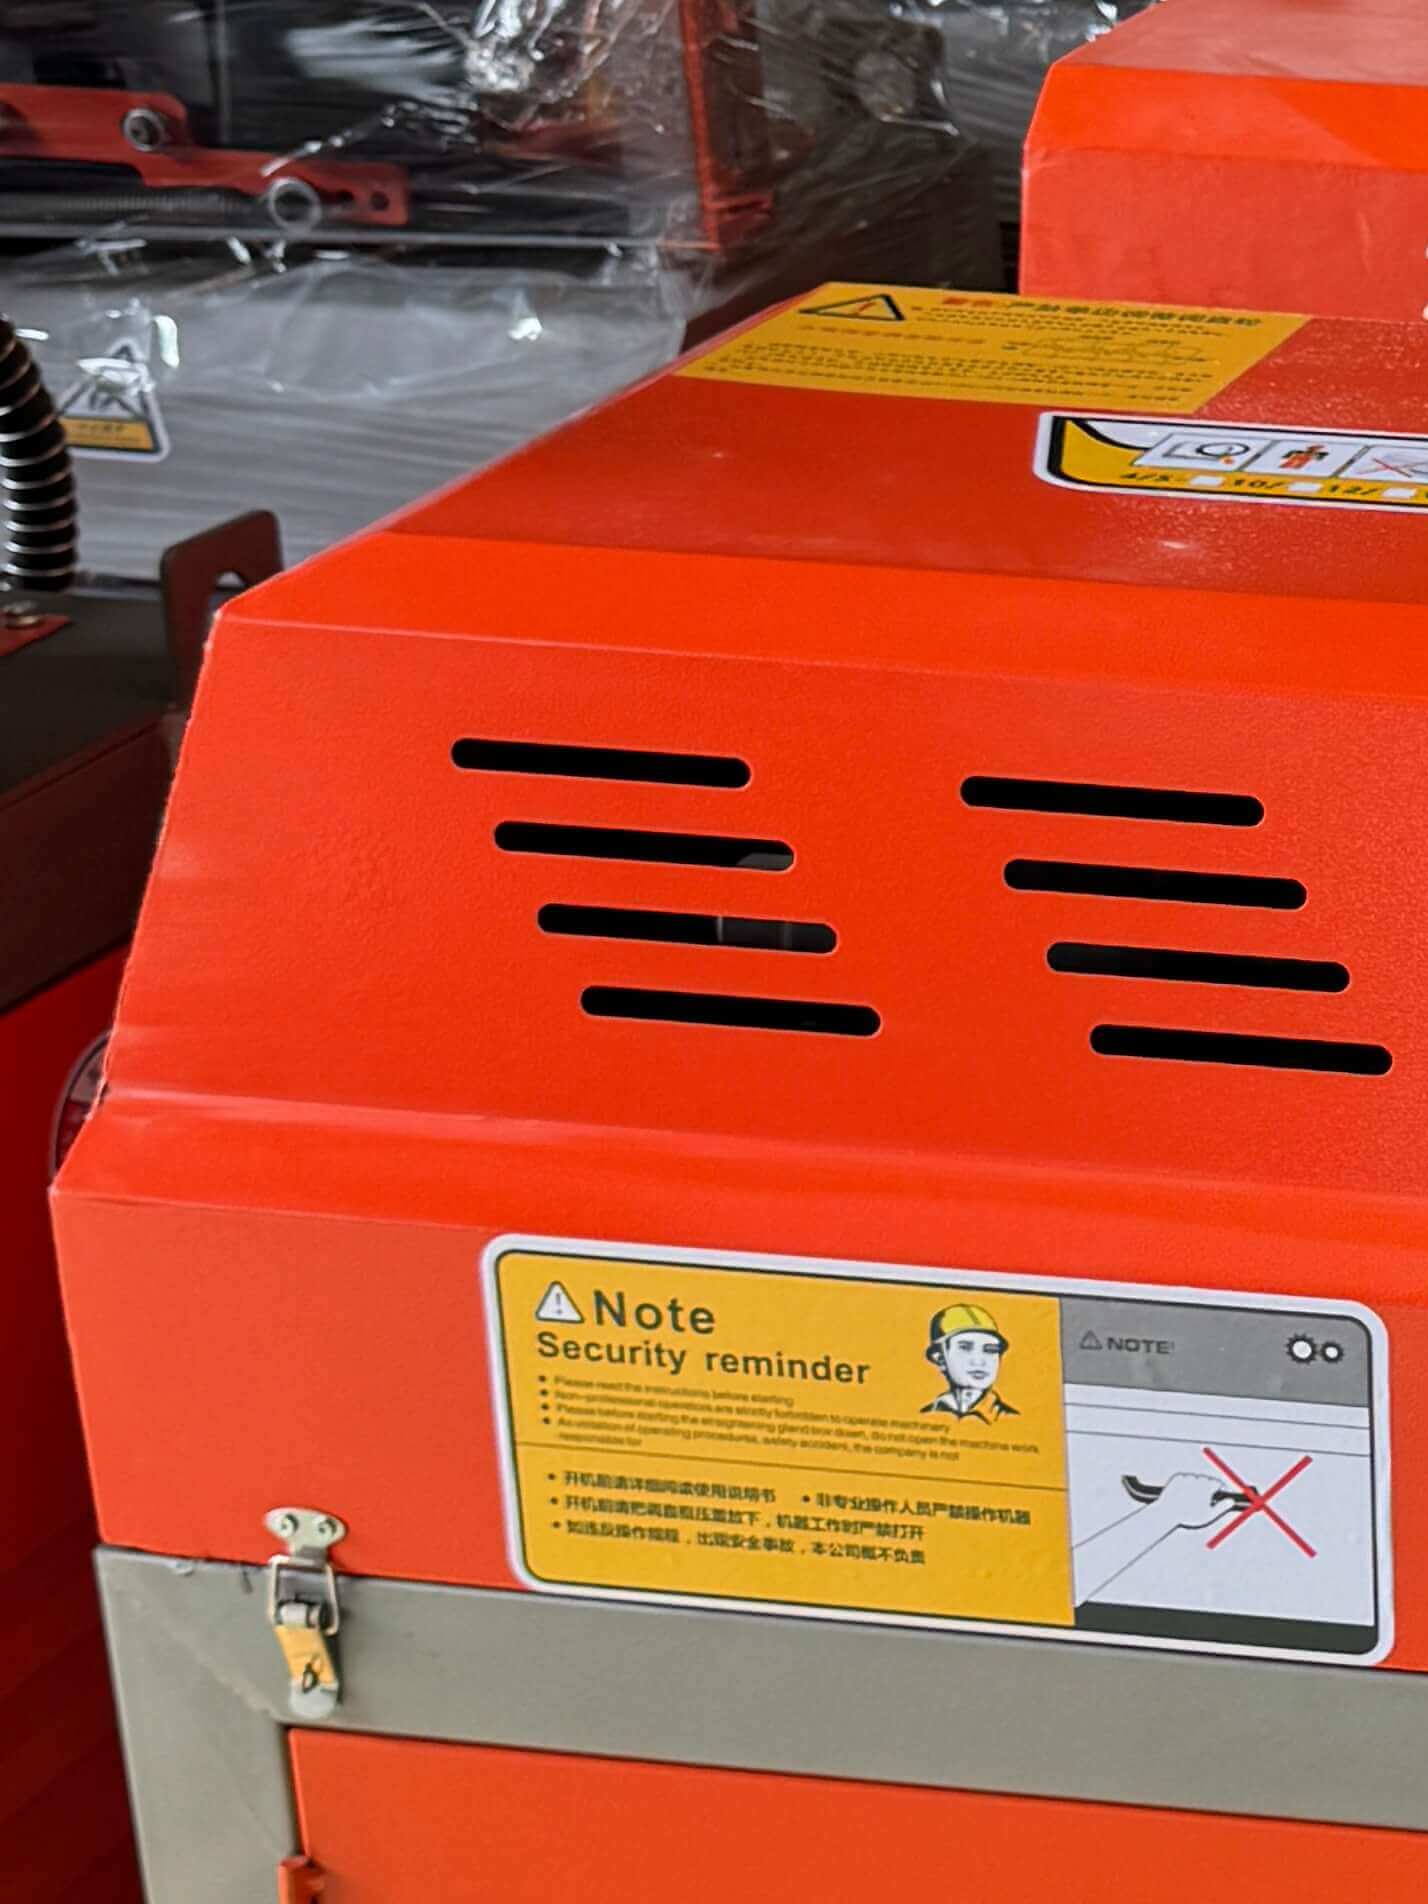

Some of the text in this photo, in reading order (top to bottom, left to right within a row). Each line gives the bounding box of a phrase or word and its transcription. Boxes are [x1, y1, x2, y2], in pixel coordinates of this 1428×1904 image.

[593, 1288, 716, 1335] Note
[536, 1330, 871, 1385] Security reminder
